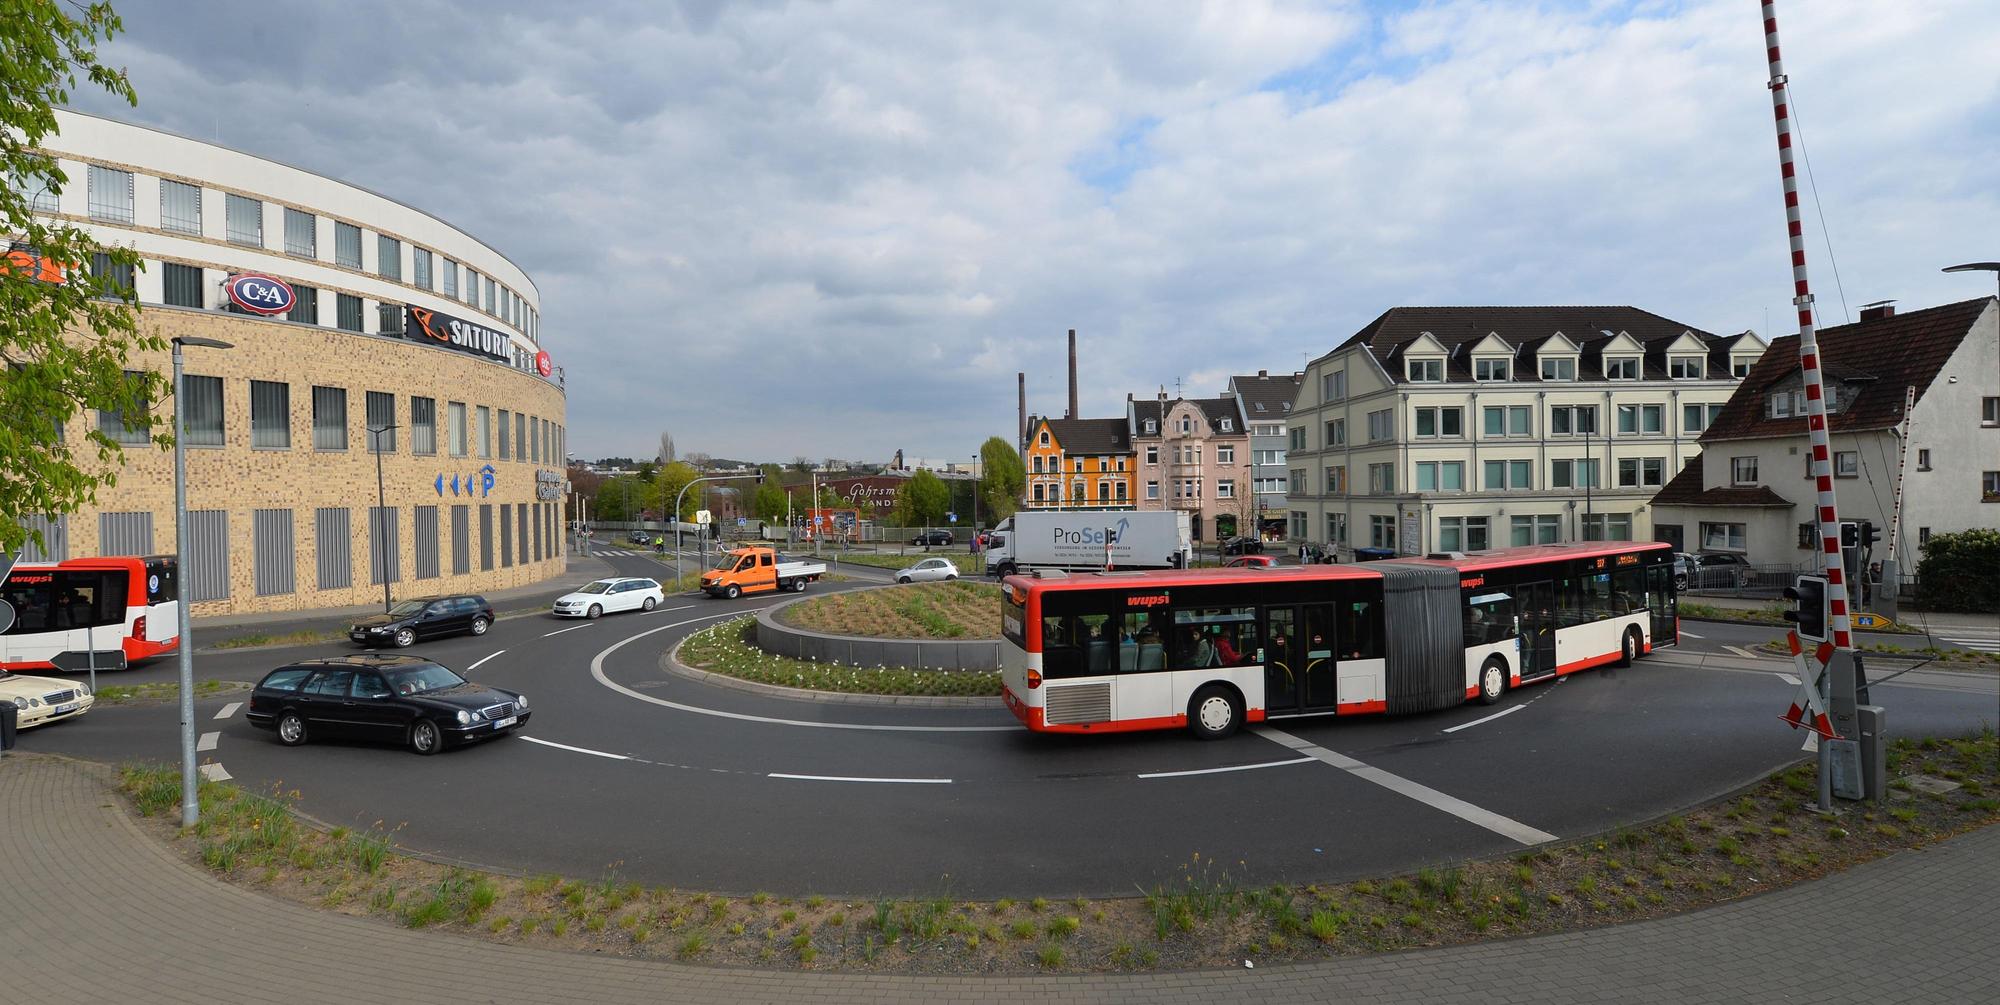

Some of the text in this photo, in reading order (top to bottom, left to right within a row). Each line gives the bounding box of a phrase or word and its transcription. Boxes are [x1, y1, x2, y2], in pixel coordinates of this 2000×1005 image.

[242, 282, 285, 304] C&A
[450, 320, 511, 359] SATURN
[11, 573, 53, 584] wupsi
[1461, 573, 1484, 589] wupsi
[1127, 591, 1170, 607] wupsi
